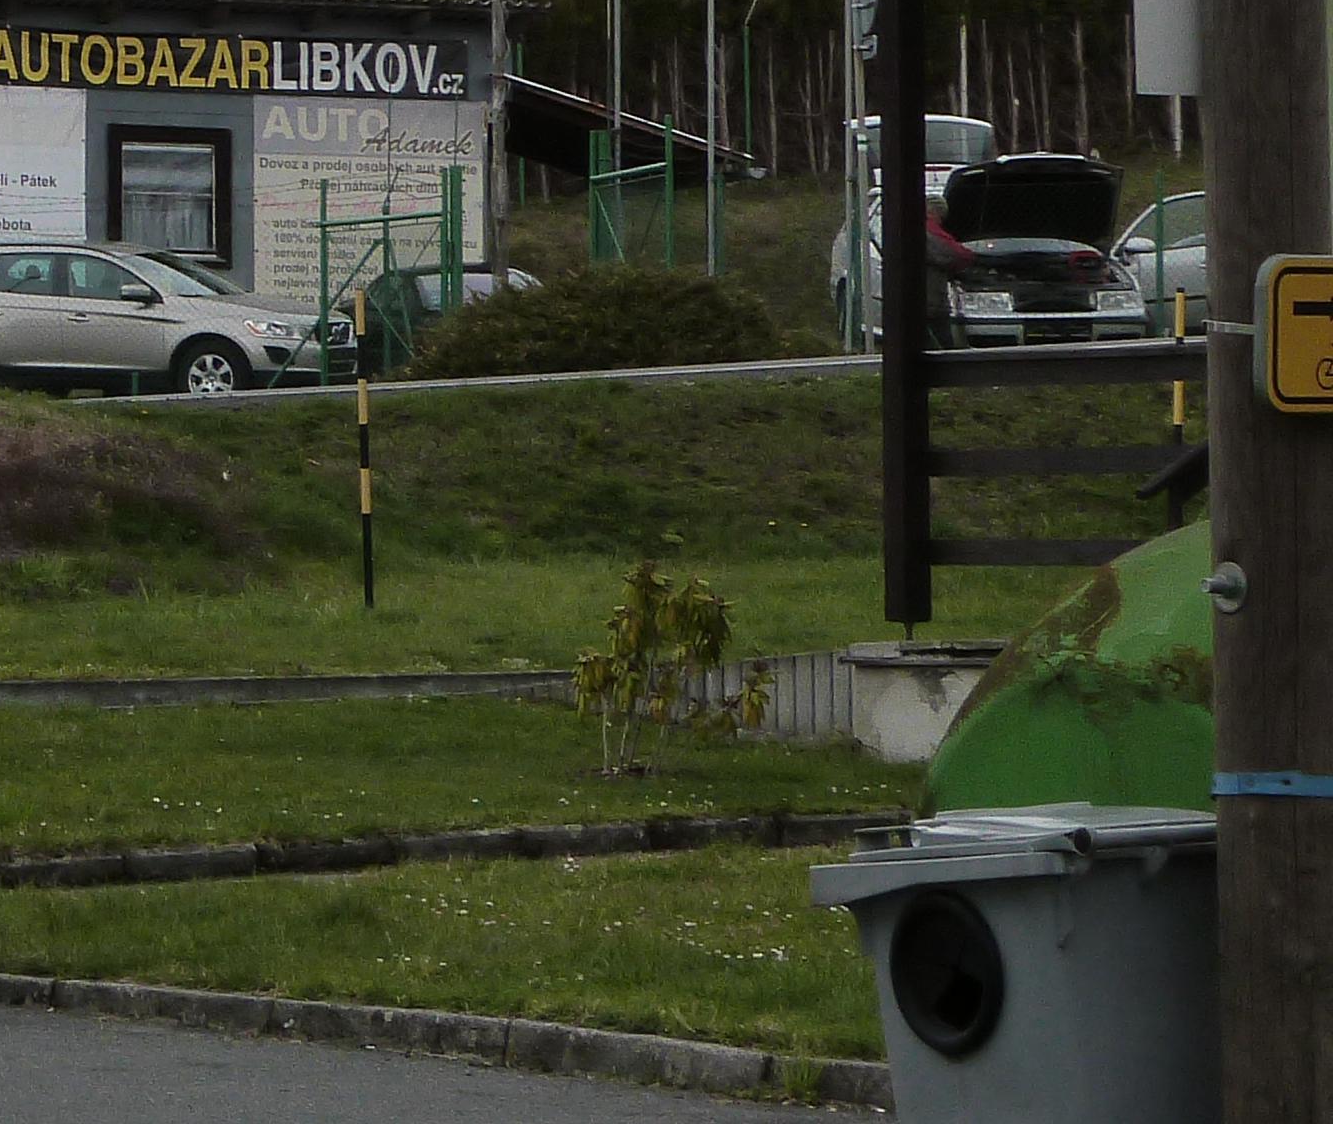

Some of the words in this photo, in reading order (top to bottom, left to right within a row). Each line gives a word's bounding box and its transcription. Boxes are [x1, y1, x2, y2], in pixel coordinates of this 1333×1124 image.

[262, 106, 390, 143] AUTO
[359, 129, 474, 155] Adámek
[259, 157, 299, 170] Dovoz
[301, 160, 310, 170] a
[312, 159, 352, 174] prodej
[415, 163, 436, 174] aut
[20, 173, 57, 188] Pátek
